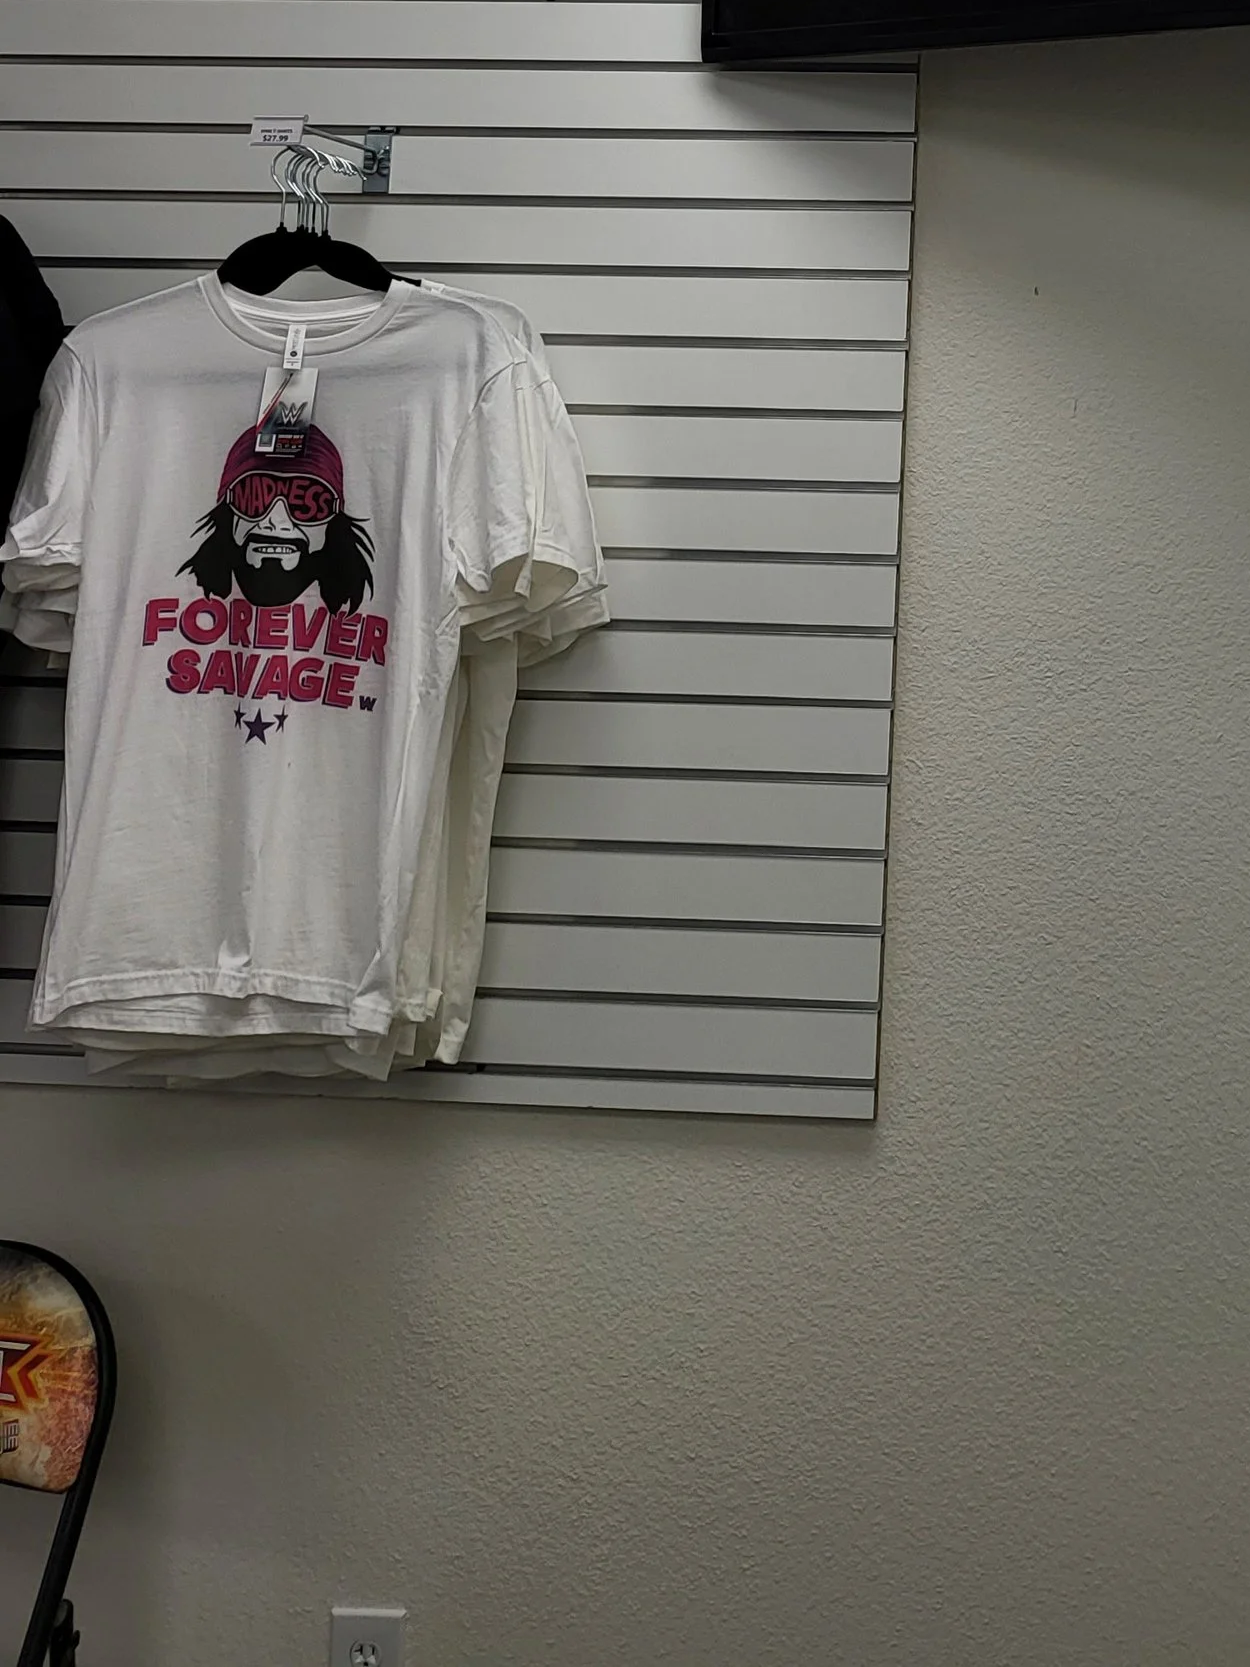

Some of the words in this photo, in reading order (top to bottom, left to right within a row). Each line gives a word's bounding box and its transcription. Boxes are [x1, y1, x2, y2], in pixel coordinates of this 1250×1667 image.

[263, 134, 289, 142] $27.99
[234, 476, 332, 521] MADNESS
[142, 598, 389, 666] FOREVER
[166, 649, 360, 709] SAVAGE
